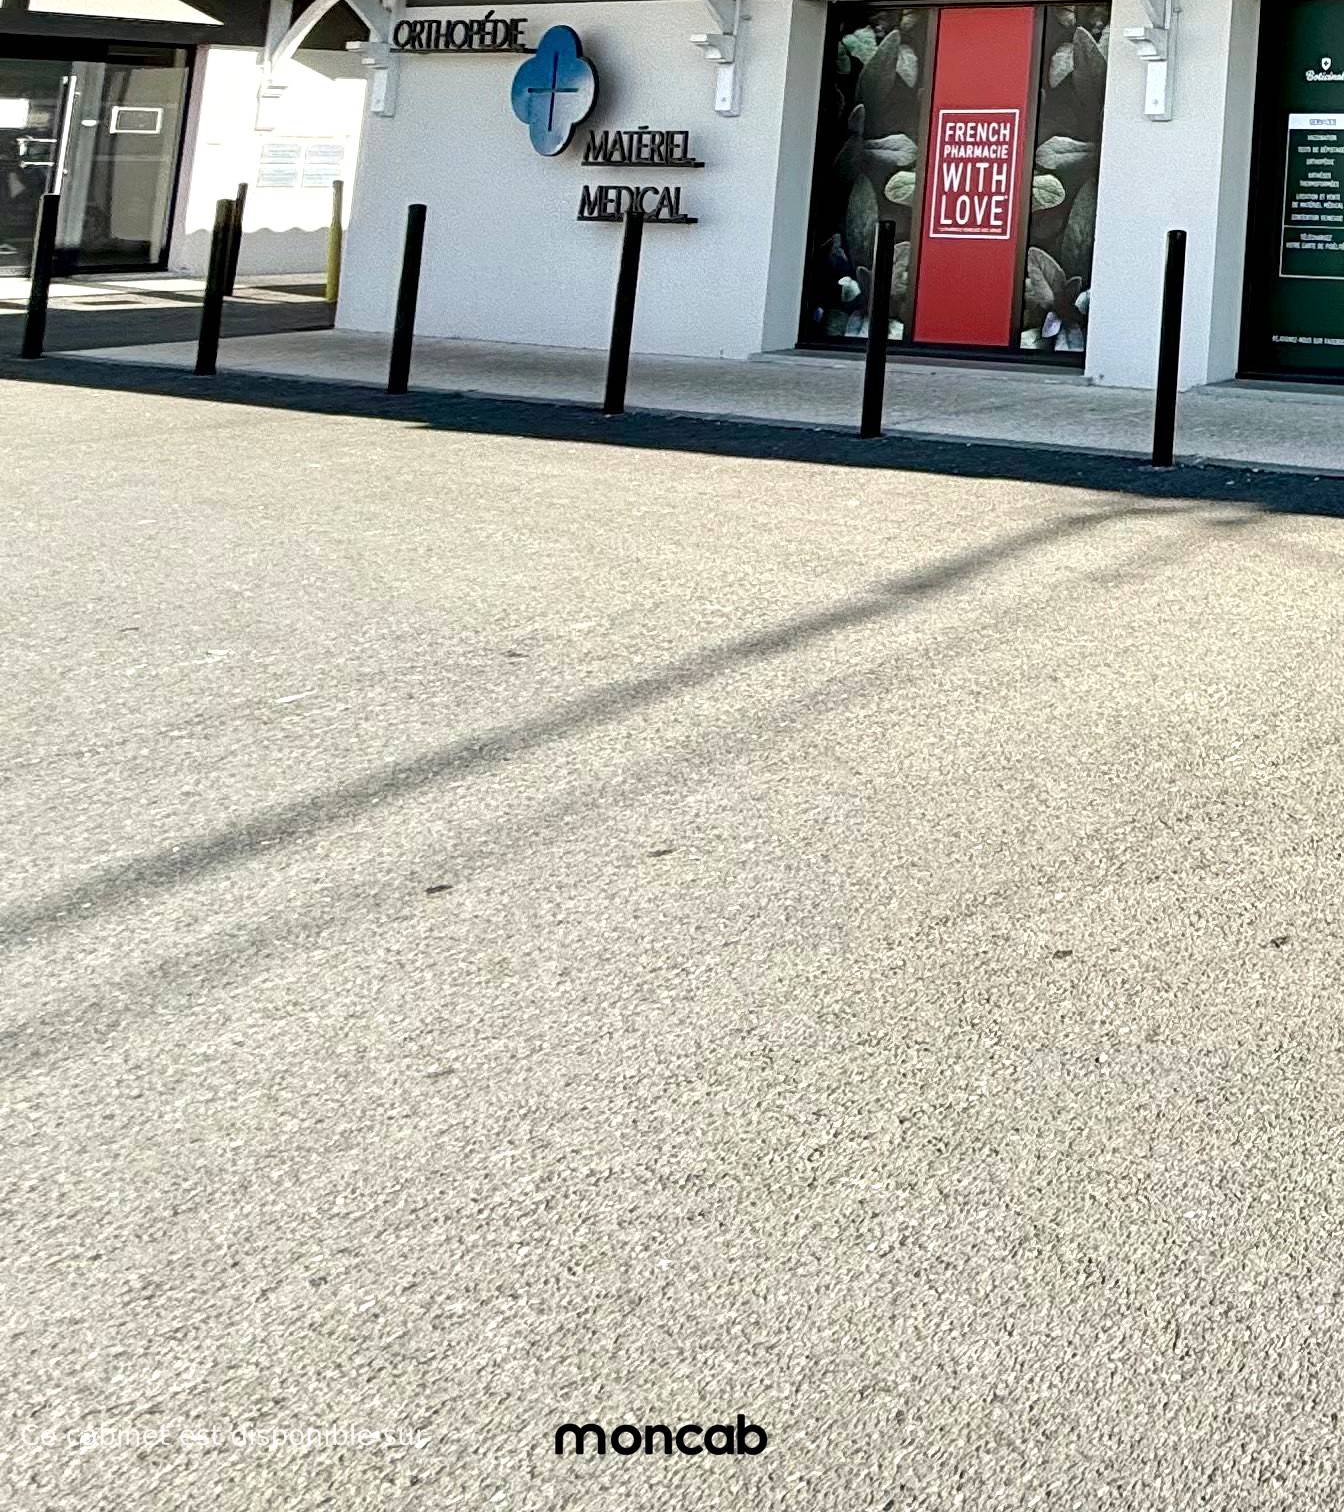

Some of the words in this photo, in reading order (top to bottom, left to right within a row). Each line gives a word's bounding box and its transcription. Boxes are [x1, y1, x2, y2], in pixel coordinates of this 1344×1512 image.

[392, 10, 528, 49] ORTHOPÉDIE
[583, 125, 696, 163] MATÉRIEL
[944, 122, 1011, 142] FRENCH
[943, 144, 1009, 159] PHARMACIE
[942, 162, 1008, 193] WITH
[578, 185, 688, 219] MEDICAL
[940, 194, 1005, 226] LOVE
